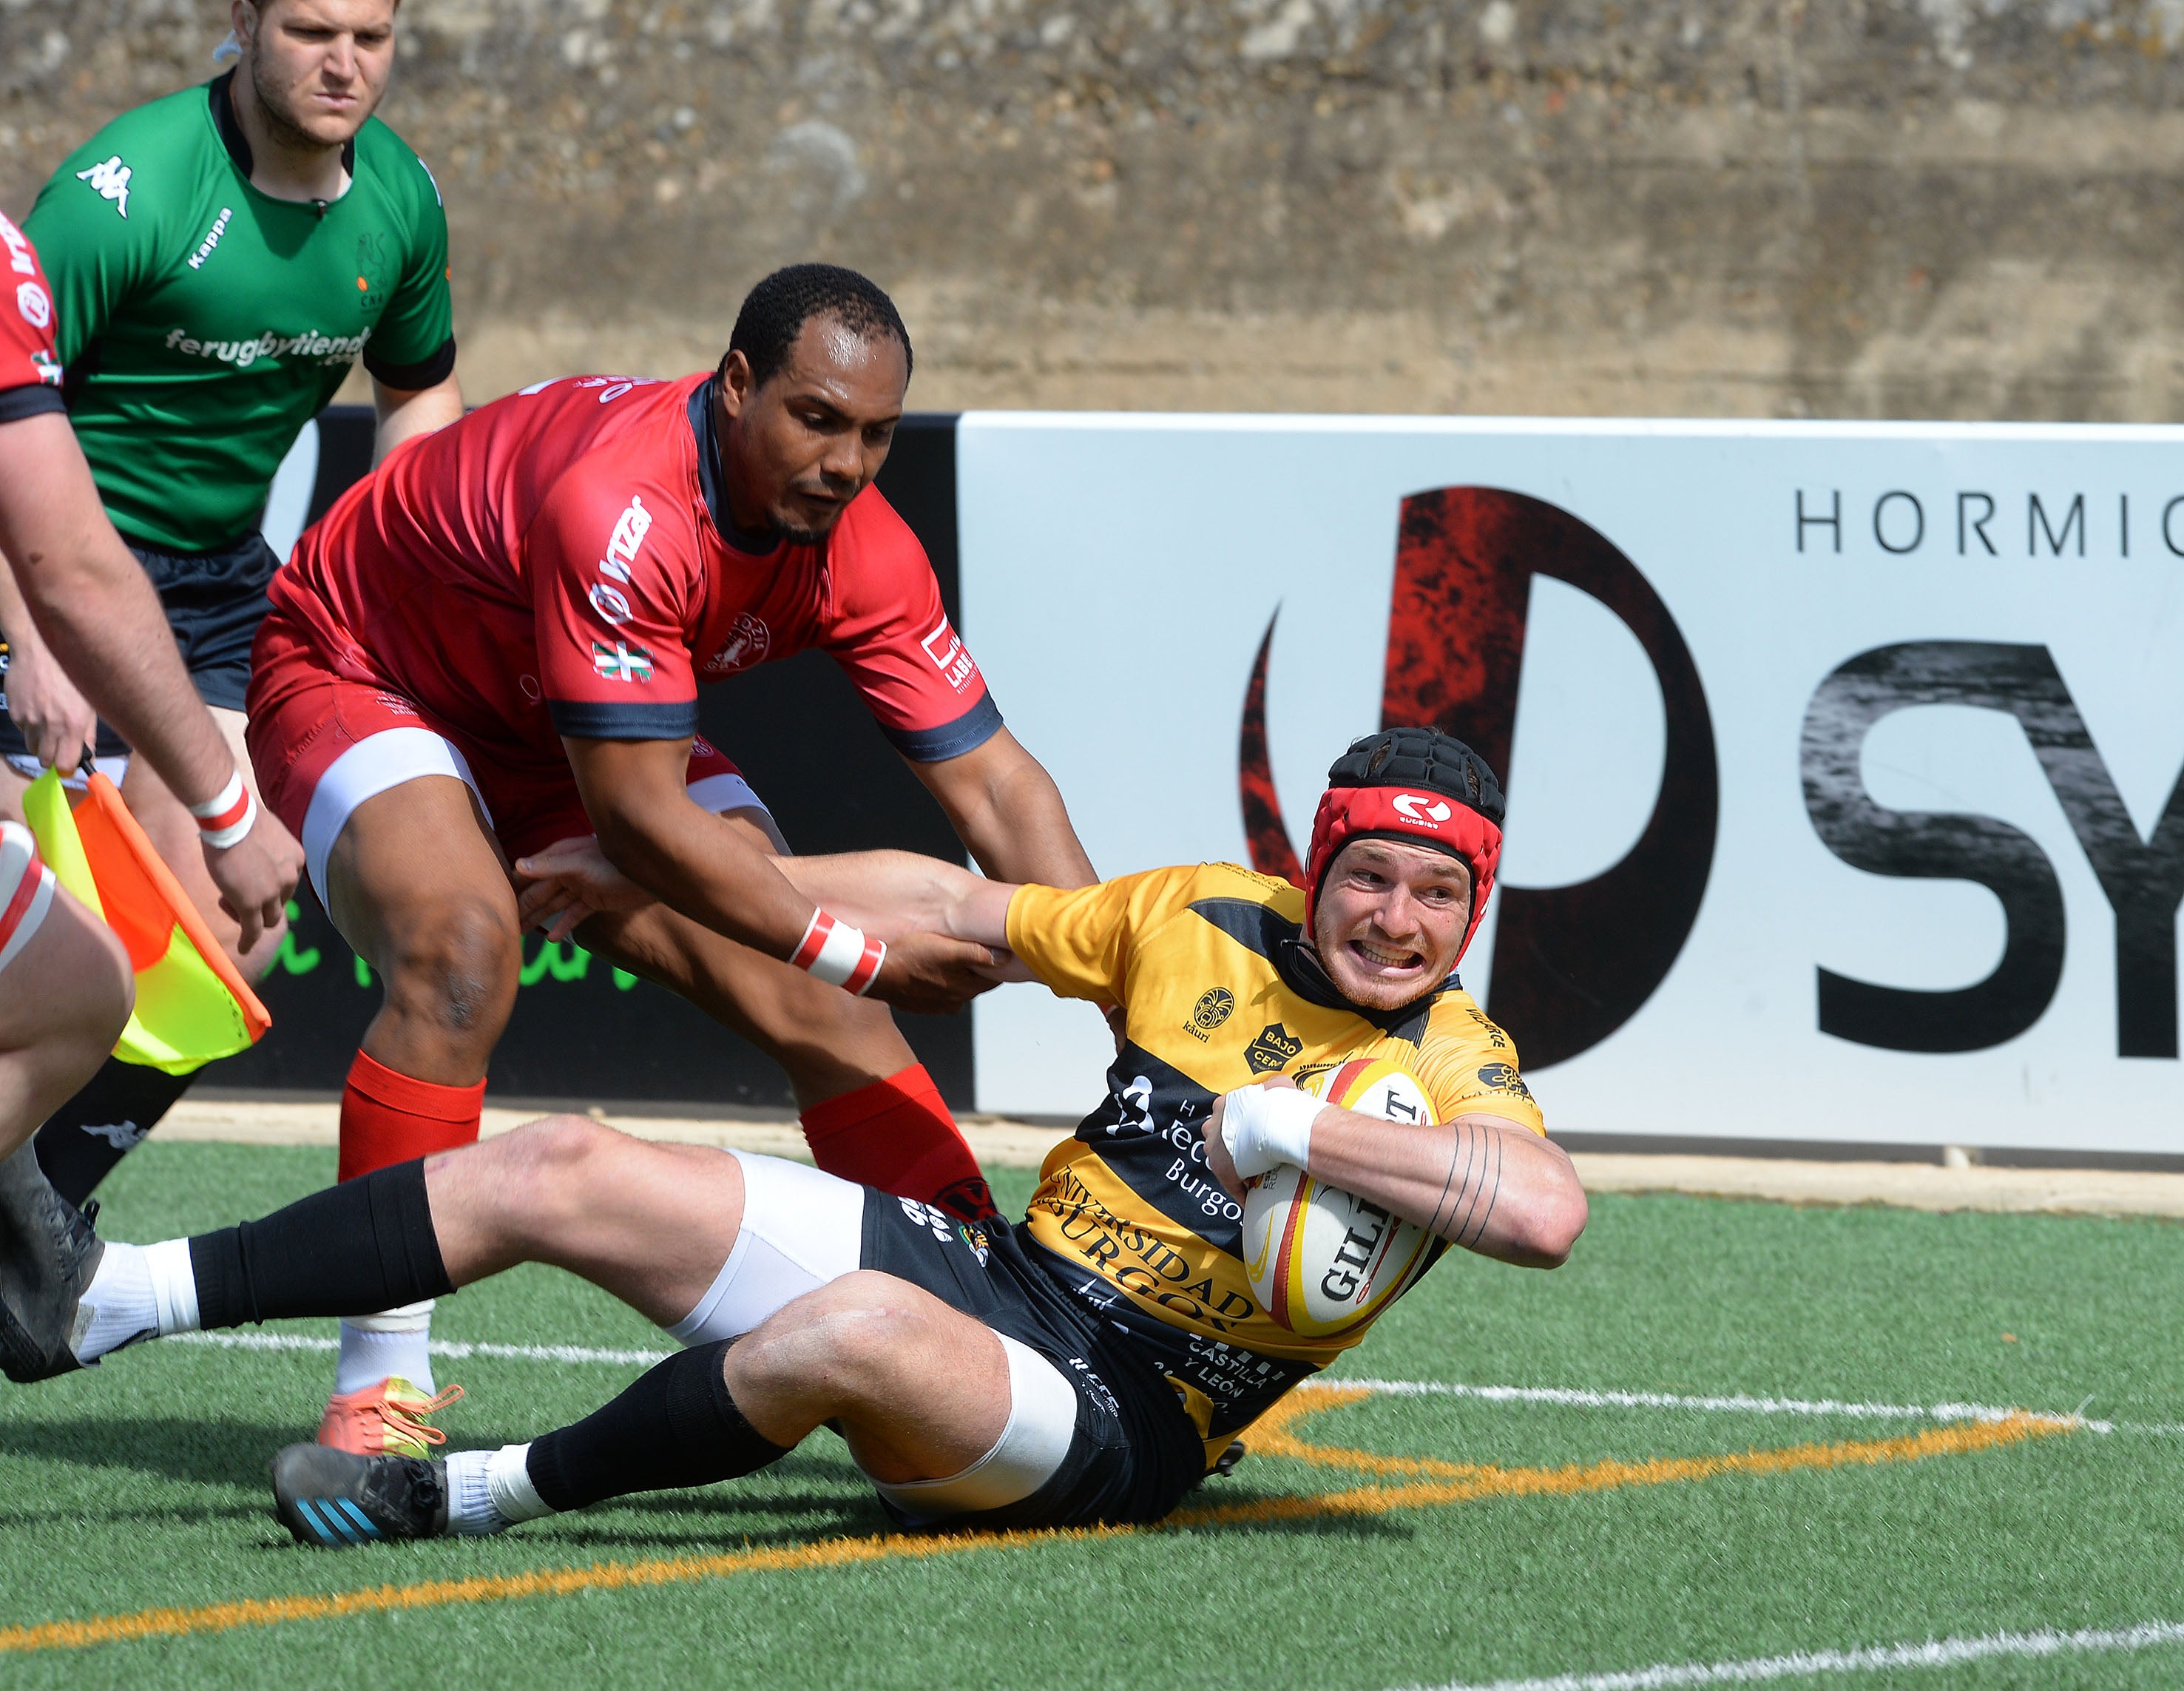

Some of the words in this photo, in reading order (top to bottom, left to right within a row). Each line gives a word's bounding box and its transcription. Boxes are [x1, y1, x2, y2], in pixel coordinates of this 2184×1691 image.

[187, 207, 232, 270] Kappa
[165, 326, 372, 367] ferugbytiend
[944, 651, 976, 689] LABE
[1265, 1030, 1296, 1055] BAJO
[1165, 1157, 1244, 1228] Burgo
[1185, 1357, 1199, 1368] Y
[1198, 1366, 1245, 1398] LEÓN
[1189, 1341, 1268, 1389] CASTILLA
